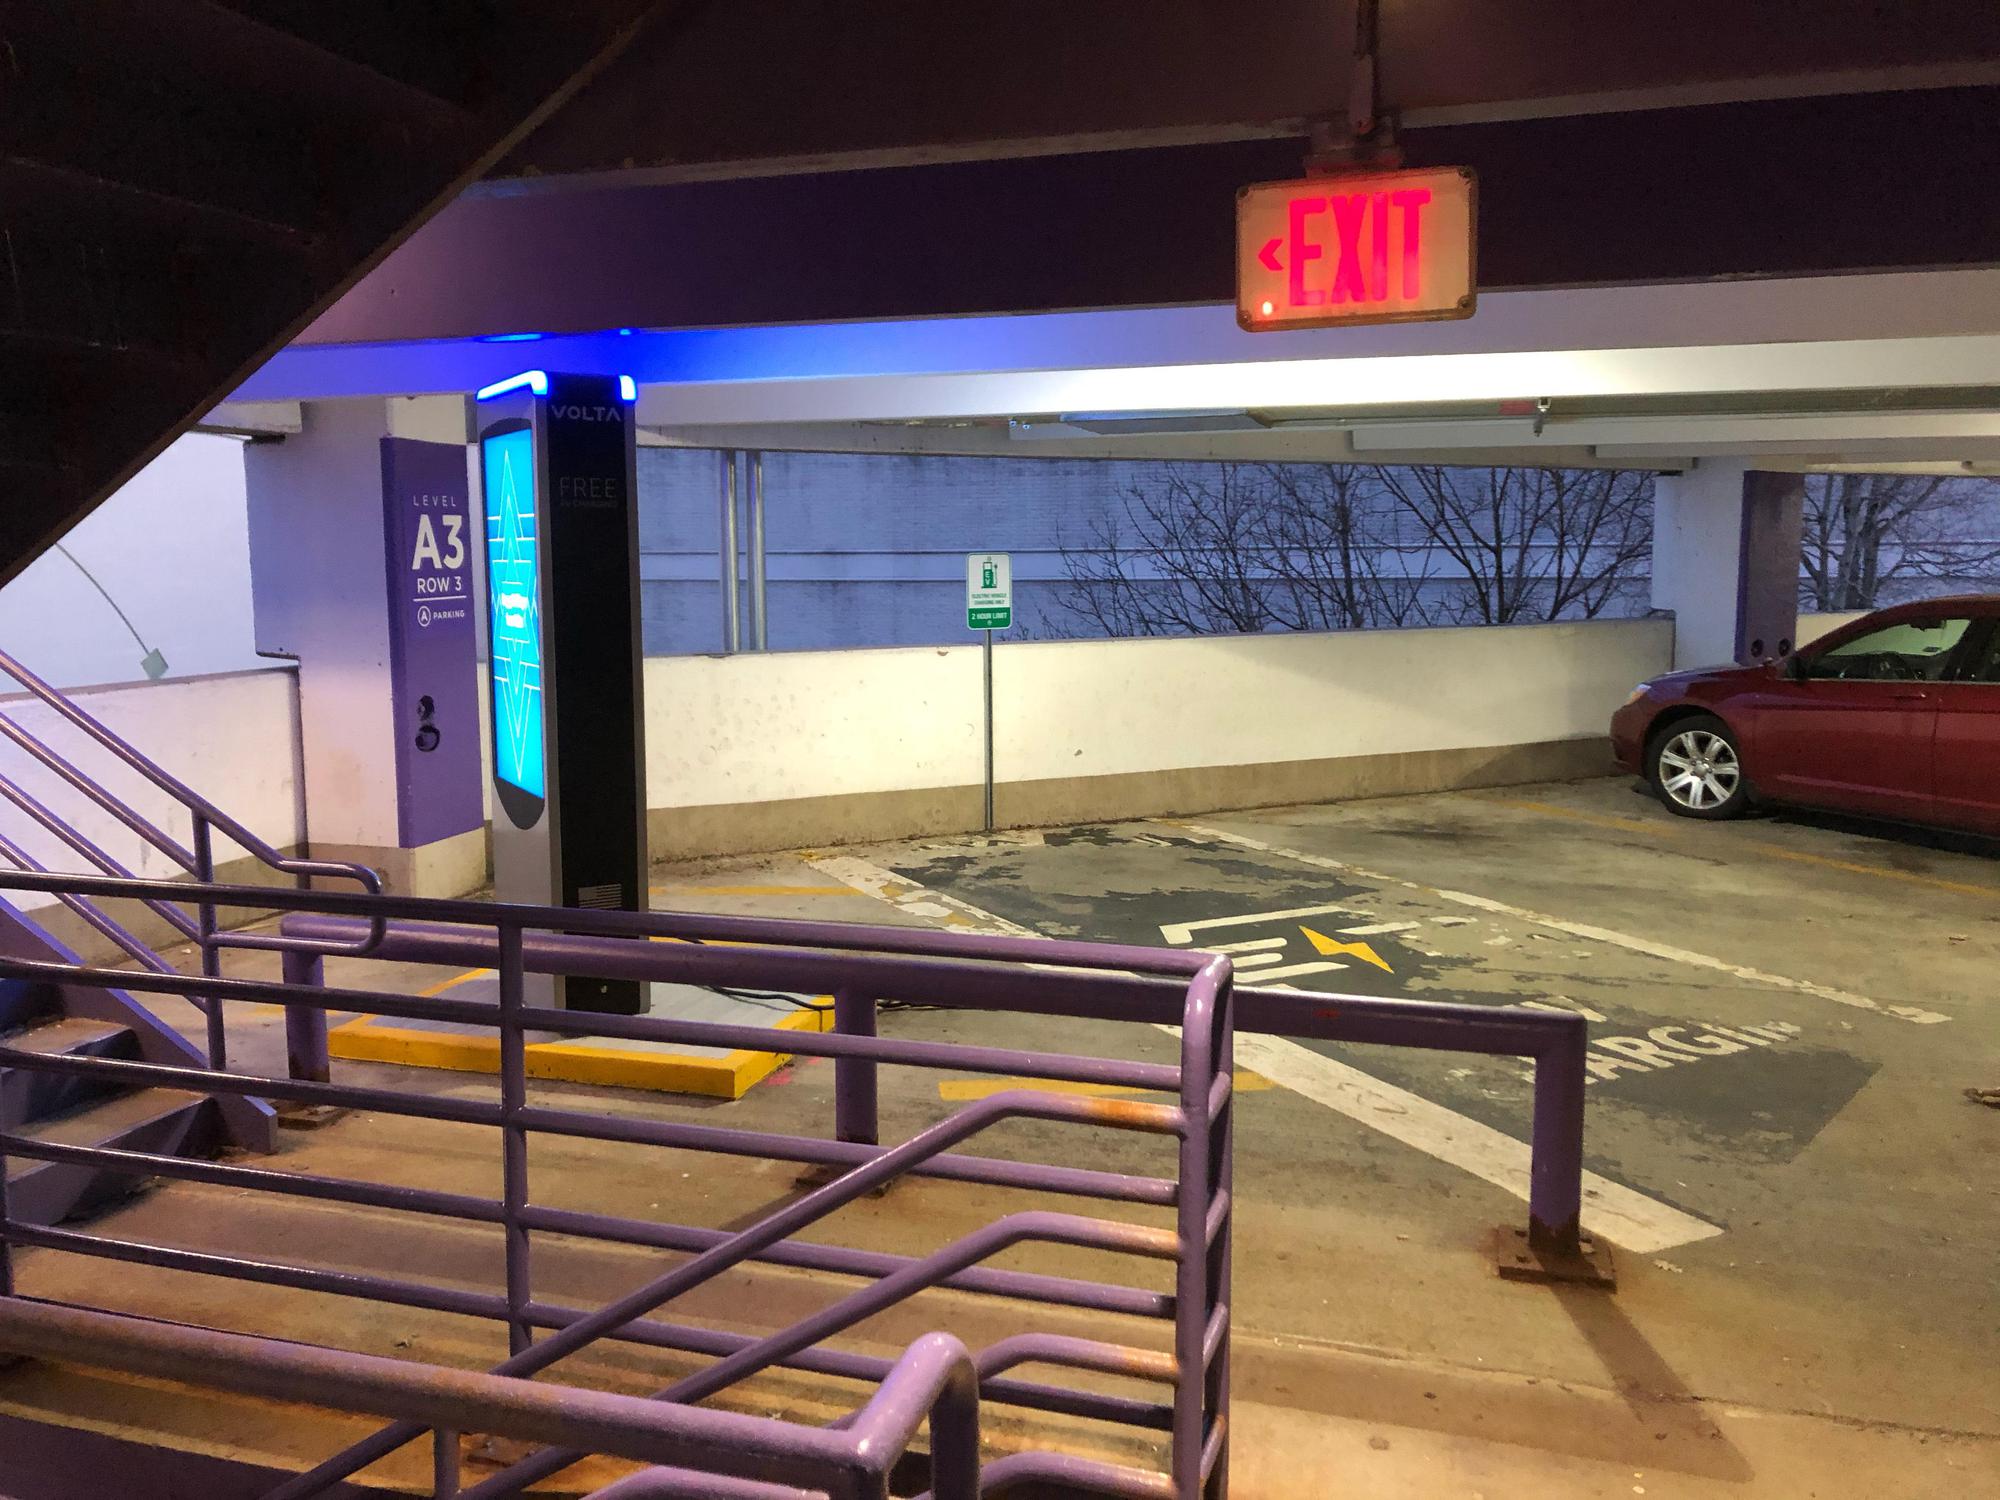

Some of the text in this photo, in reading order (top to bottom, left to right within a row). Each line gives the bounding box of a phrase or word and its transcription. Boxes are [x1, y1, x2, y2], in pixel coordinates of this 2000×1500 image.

[1288, 190, 1431, 306] EXIT
[551, 404, 622, 422] VOLTA
[560, 476, 617, 498] FREE
[413, 495, 456, 507] LEVEL
[412, 513, 465, 570] A3
[417, 576, 462, 593] ROW 3
[433, 609, 465, 620] PARKING
